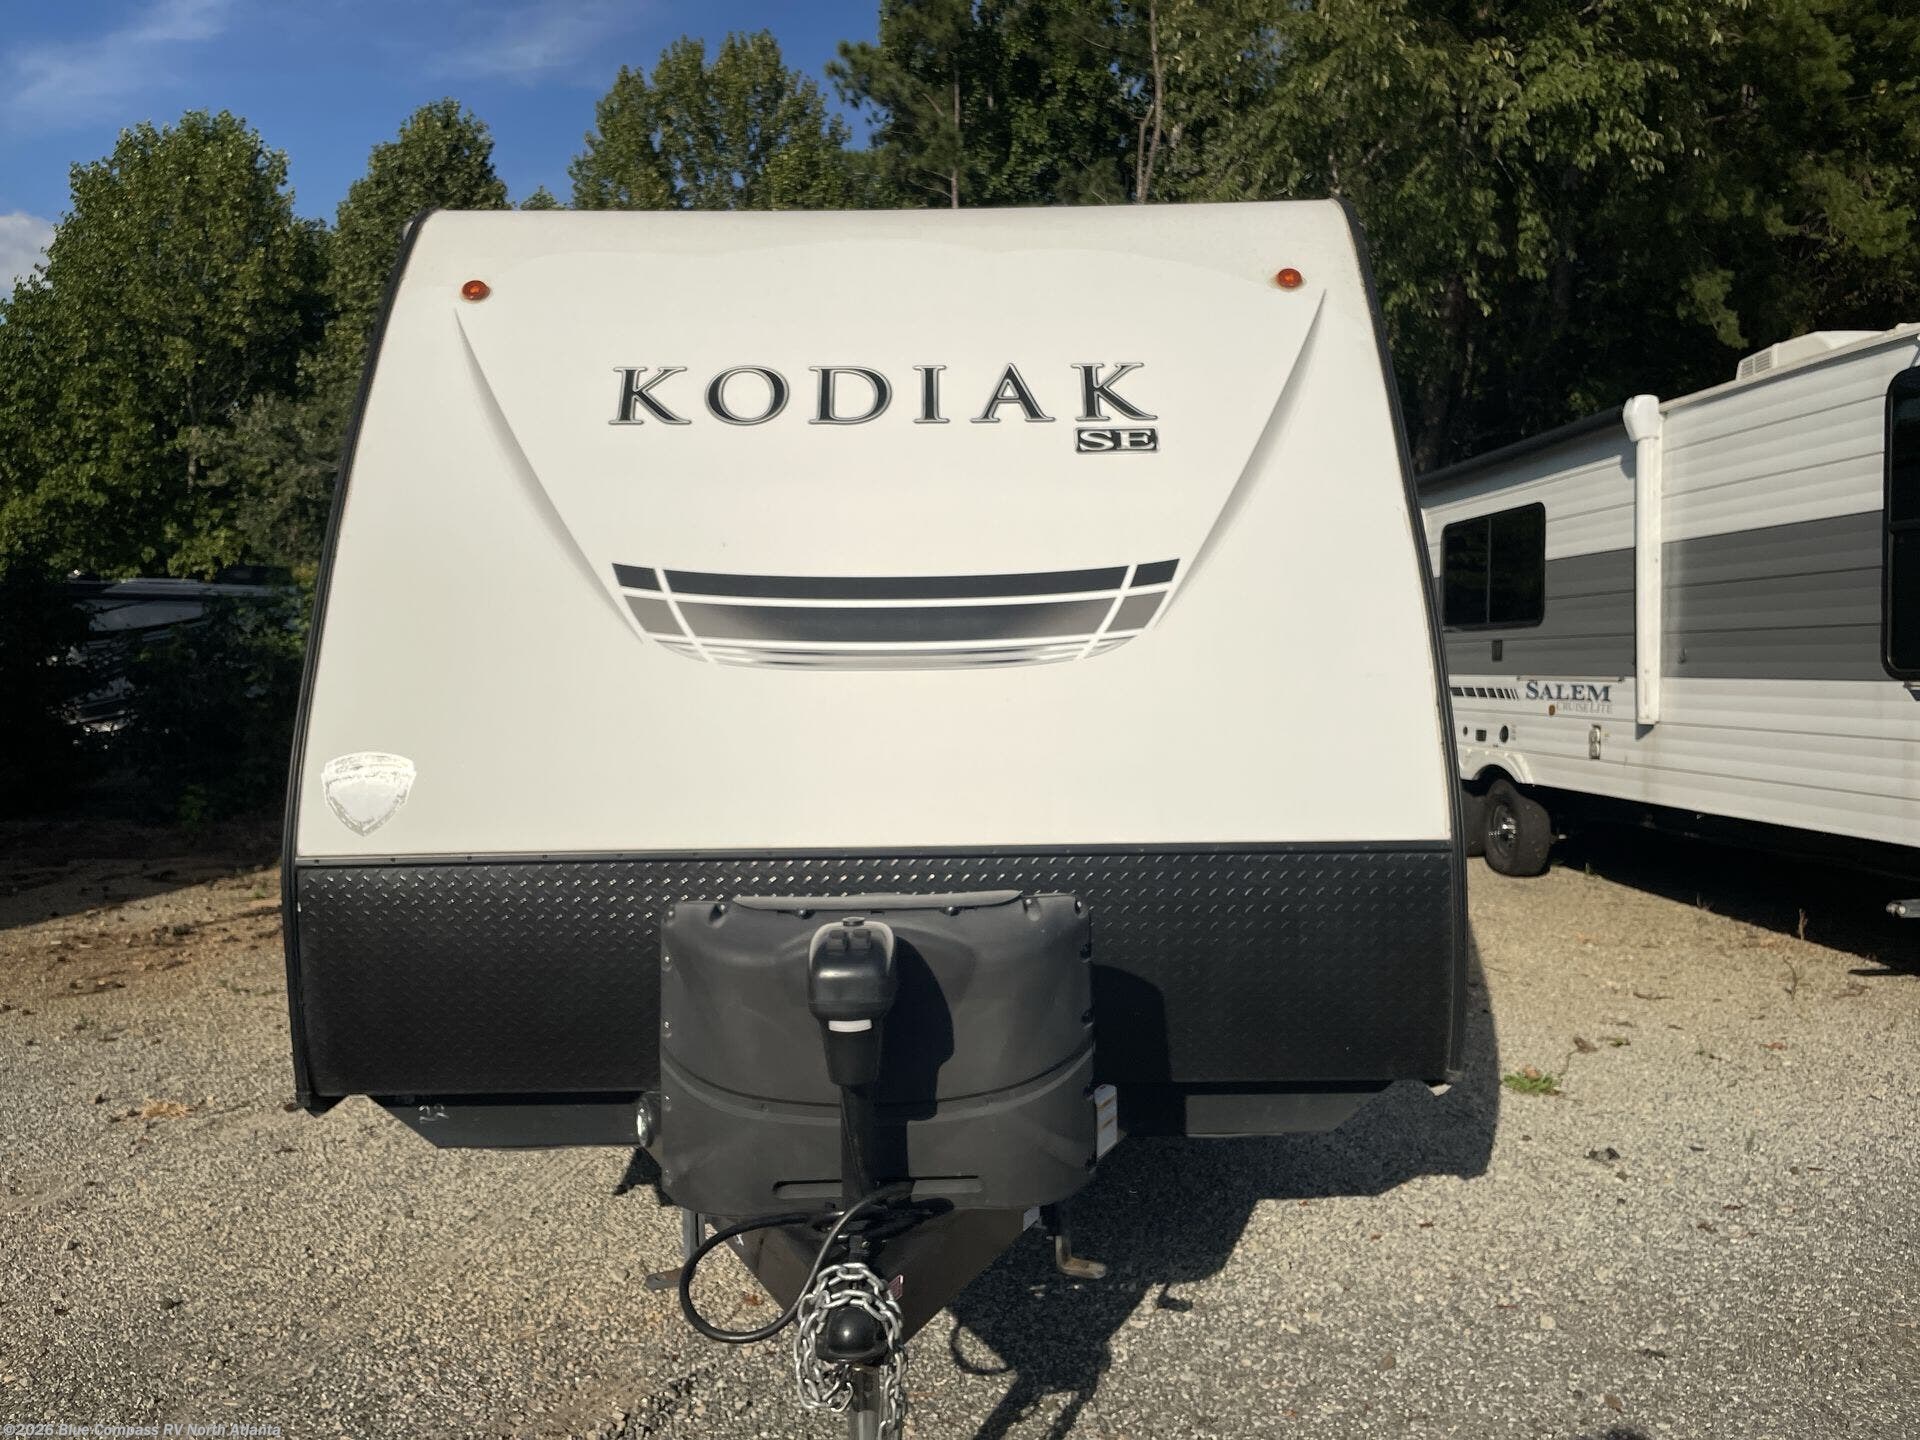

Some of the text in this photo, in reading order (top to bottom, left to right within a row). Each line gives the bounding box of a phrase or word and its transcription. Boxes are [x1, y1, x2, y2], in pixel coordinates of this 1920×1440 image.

[607, 361, 1159, 425] KODIAK
[1078, 428, 1156, 452] SE
[1525, 680, 1611, 702] SALEM
